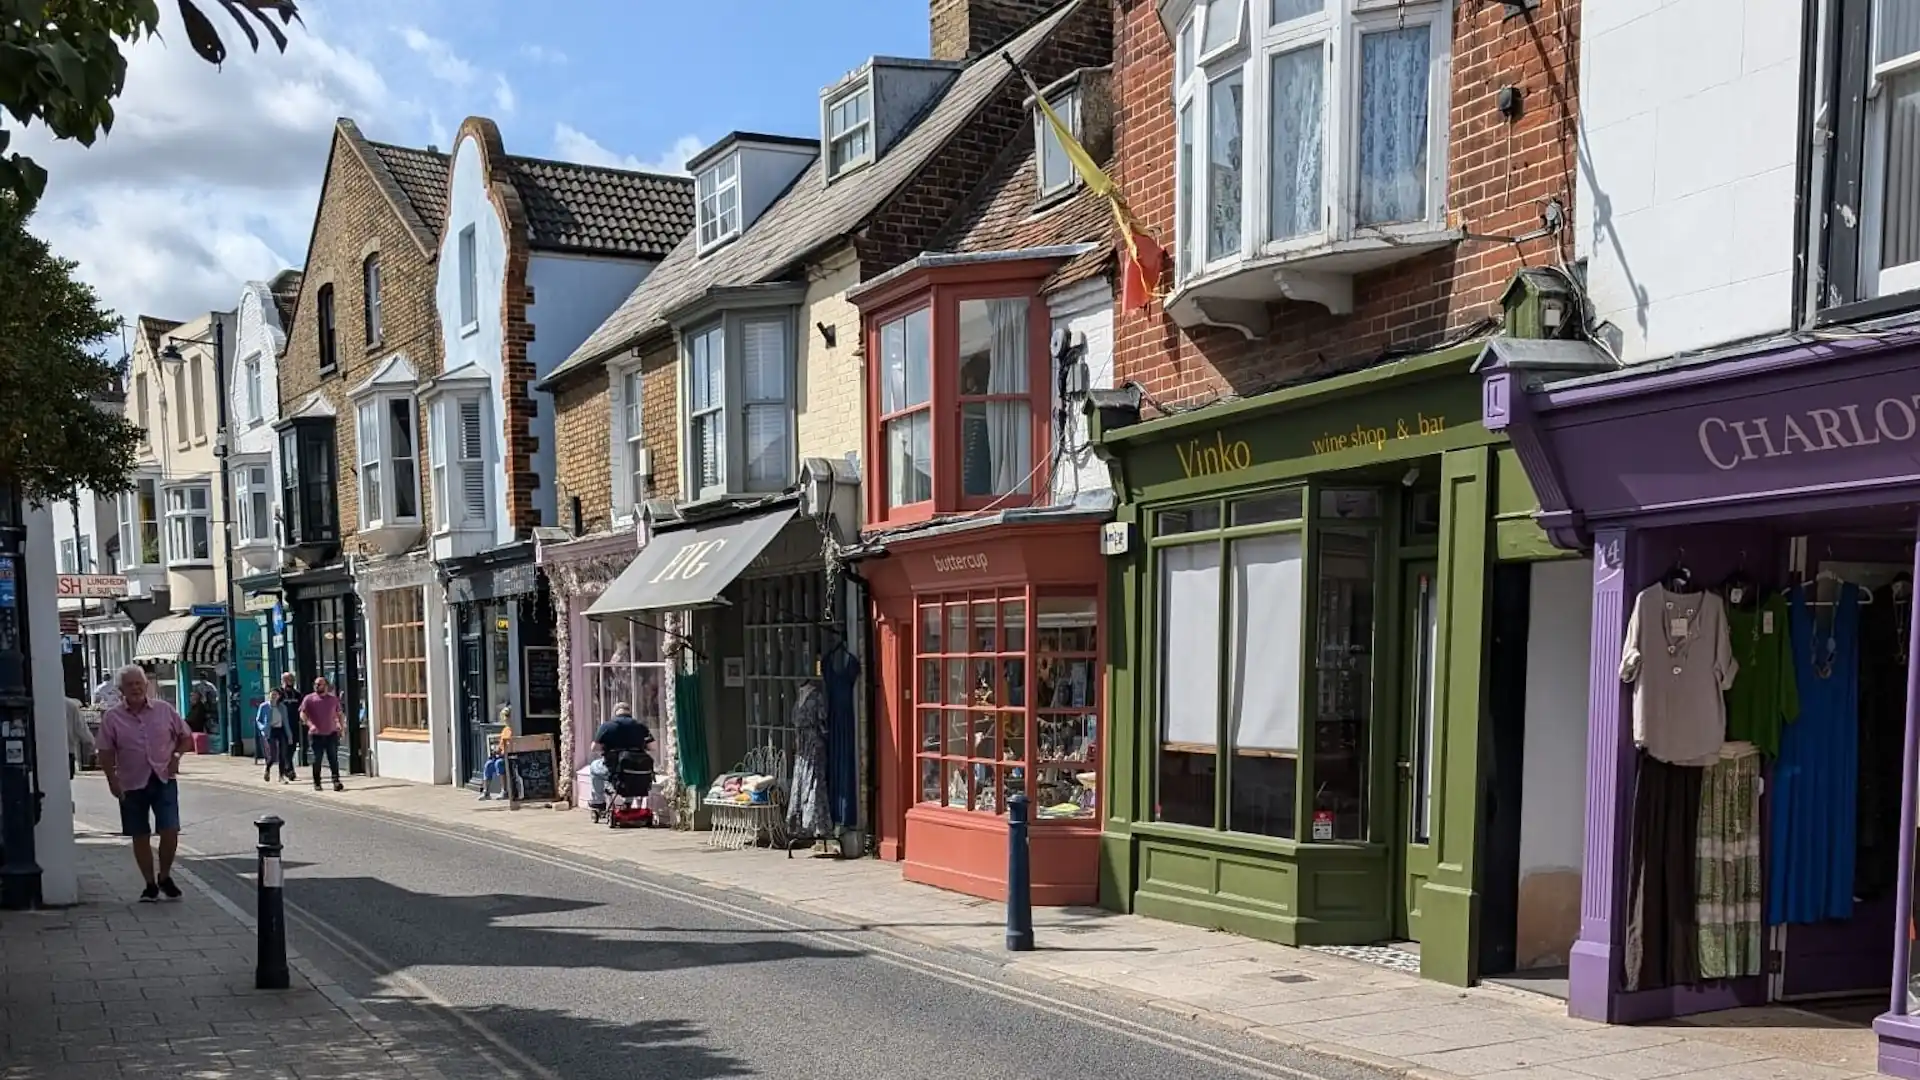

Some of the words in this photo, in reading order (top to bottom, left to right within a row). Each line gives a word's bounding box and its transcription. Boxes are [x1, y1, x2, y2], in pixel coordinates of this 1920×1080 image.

[1176, 430, 1251, 480] Vinko
[1312, 432, 1347, 455] wine
[1350, 423, 1387, 451] shop
[1396, 418, 1410, 440] &
[1417, 412, 1445, 436] bar
[1698, 394, 1920, 470] CHARLO
[932, 553, 988, 573] buttercup
